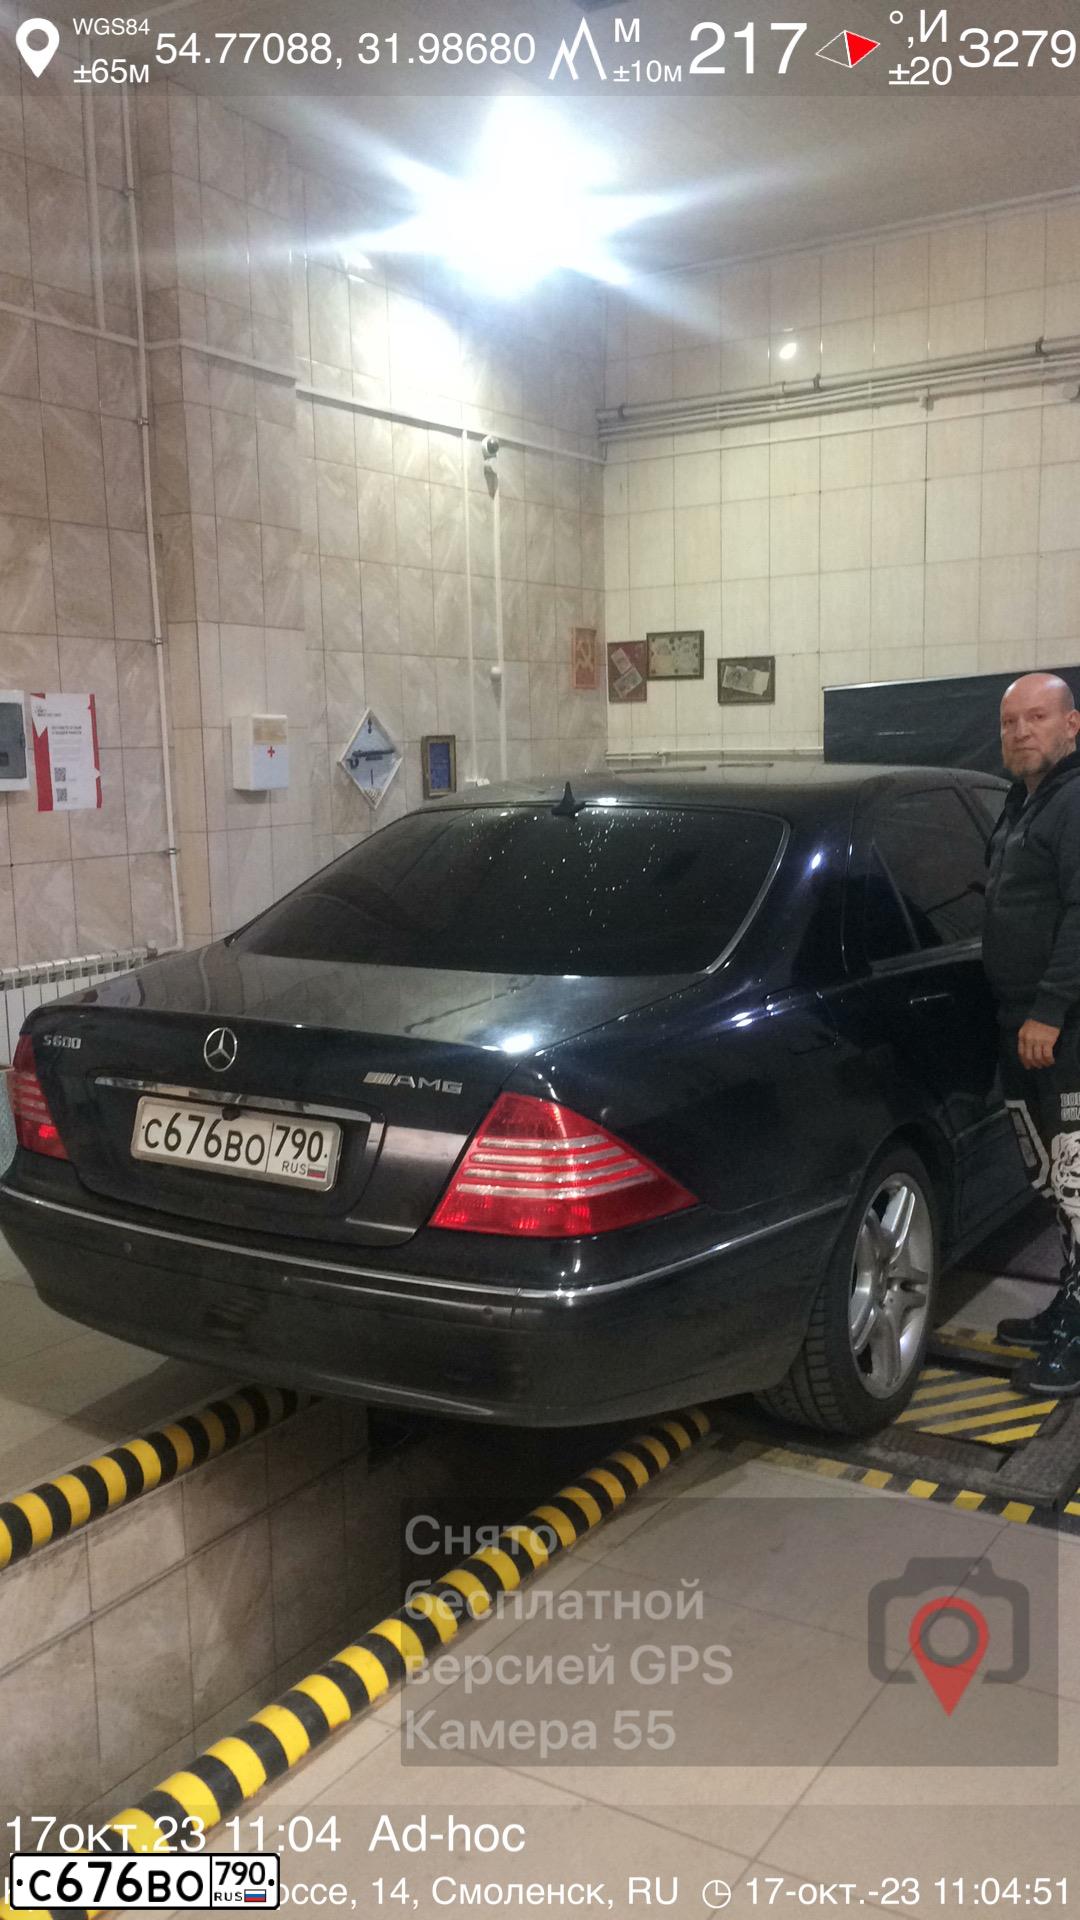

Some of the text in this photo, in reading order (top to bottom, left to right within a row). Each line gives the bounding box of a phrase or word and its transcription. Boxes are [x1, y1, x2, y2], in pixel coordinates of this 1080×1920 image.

[43, 1034, 82, 1049] S600
[393, 1074, 463, 1095] AMG
[274, 1124, 324, 1162] 790
[281, 1160, 307, 1176] RUS
